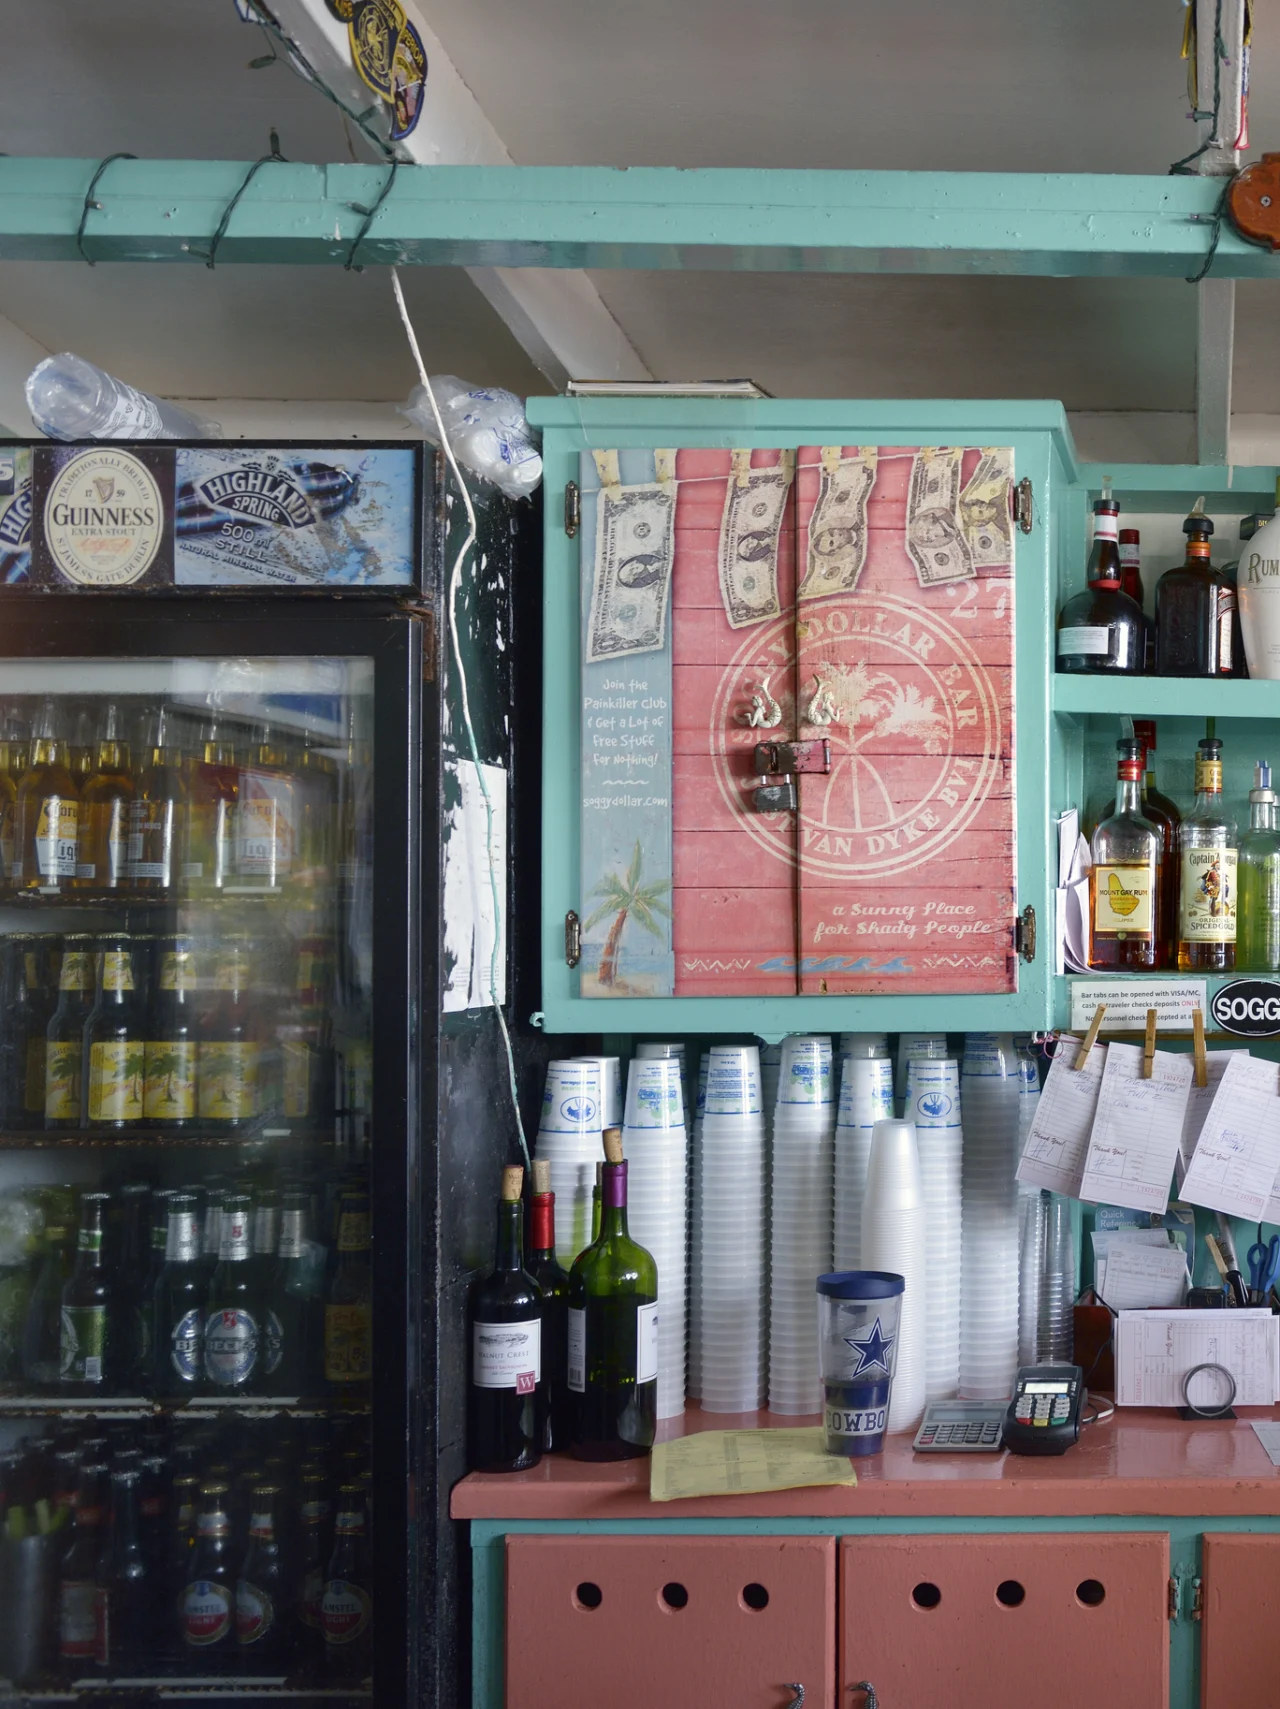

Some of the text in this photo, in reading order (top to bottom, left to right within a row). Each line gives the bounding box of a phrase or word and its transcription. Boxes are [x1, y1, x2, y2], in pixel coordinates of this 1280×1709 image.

[59, 457, 150, 500] TRADITIONALLY BREWED
[116, 490, 126, 498] 59
[206, 472, 310, 524] HIGHLAND
[53, 503, 154, 527] GUINNESS
[232, 496, 280, 521] SPRING
[72, 528, 136, 536] EXTRA STOUT
[221, 522, 254, 543] 500
[215, 538, 268, 563] STILL
[96, 540, 150, 583] GATE DUBLIN
[180, 543, 297, 584] NATURAL MINERAL WATER
[804, 611, 978, 730] DOLLAR BAR
[603, 679, 648, 693] Join the
[584, 696, 638, 710] Painkiller
[596, 716, 616, 731] Get
[619, 718, 626, 728] a
[628, 716, 648, 730] Lot
[652, 716, 664, 728] of
[582, 794, 668, 810] soggydollar.com
[802, 756, 974, 858] VAN DYKE BVI
[1189, 852, 1215, 866] Captain
[832, 901, 976, 920] a Sunny Place
[814, 920, 993, 944] for Shady People
[1130, 992, 1154, 1000] opened
[1100, 1210, 1124, 1219] Quick
[520, 1376, 534, 1389] W
